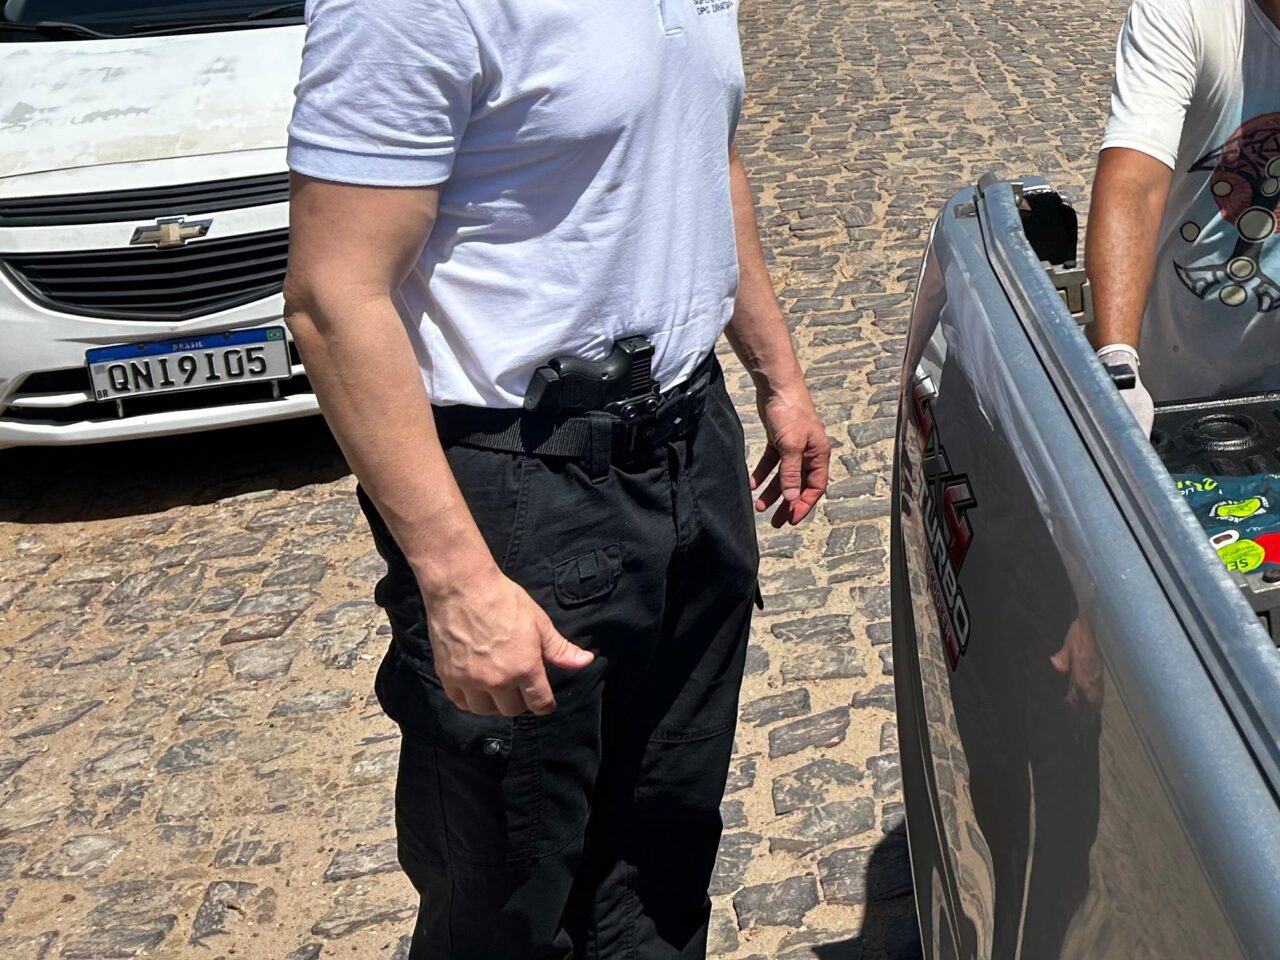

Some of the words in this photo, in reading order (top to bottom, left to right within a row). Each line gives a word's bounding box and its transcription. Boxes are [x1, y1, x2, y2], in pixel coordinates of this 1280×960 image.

[172, 340, 204, 352] BRASIL
[96, 388, 110, 399] BR
[918, 470, 970, 647] TURBO
[1221, 558, 1249, 571] SE
